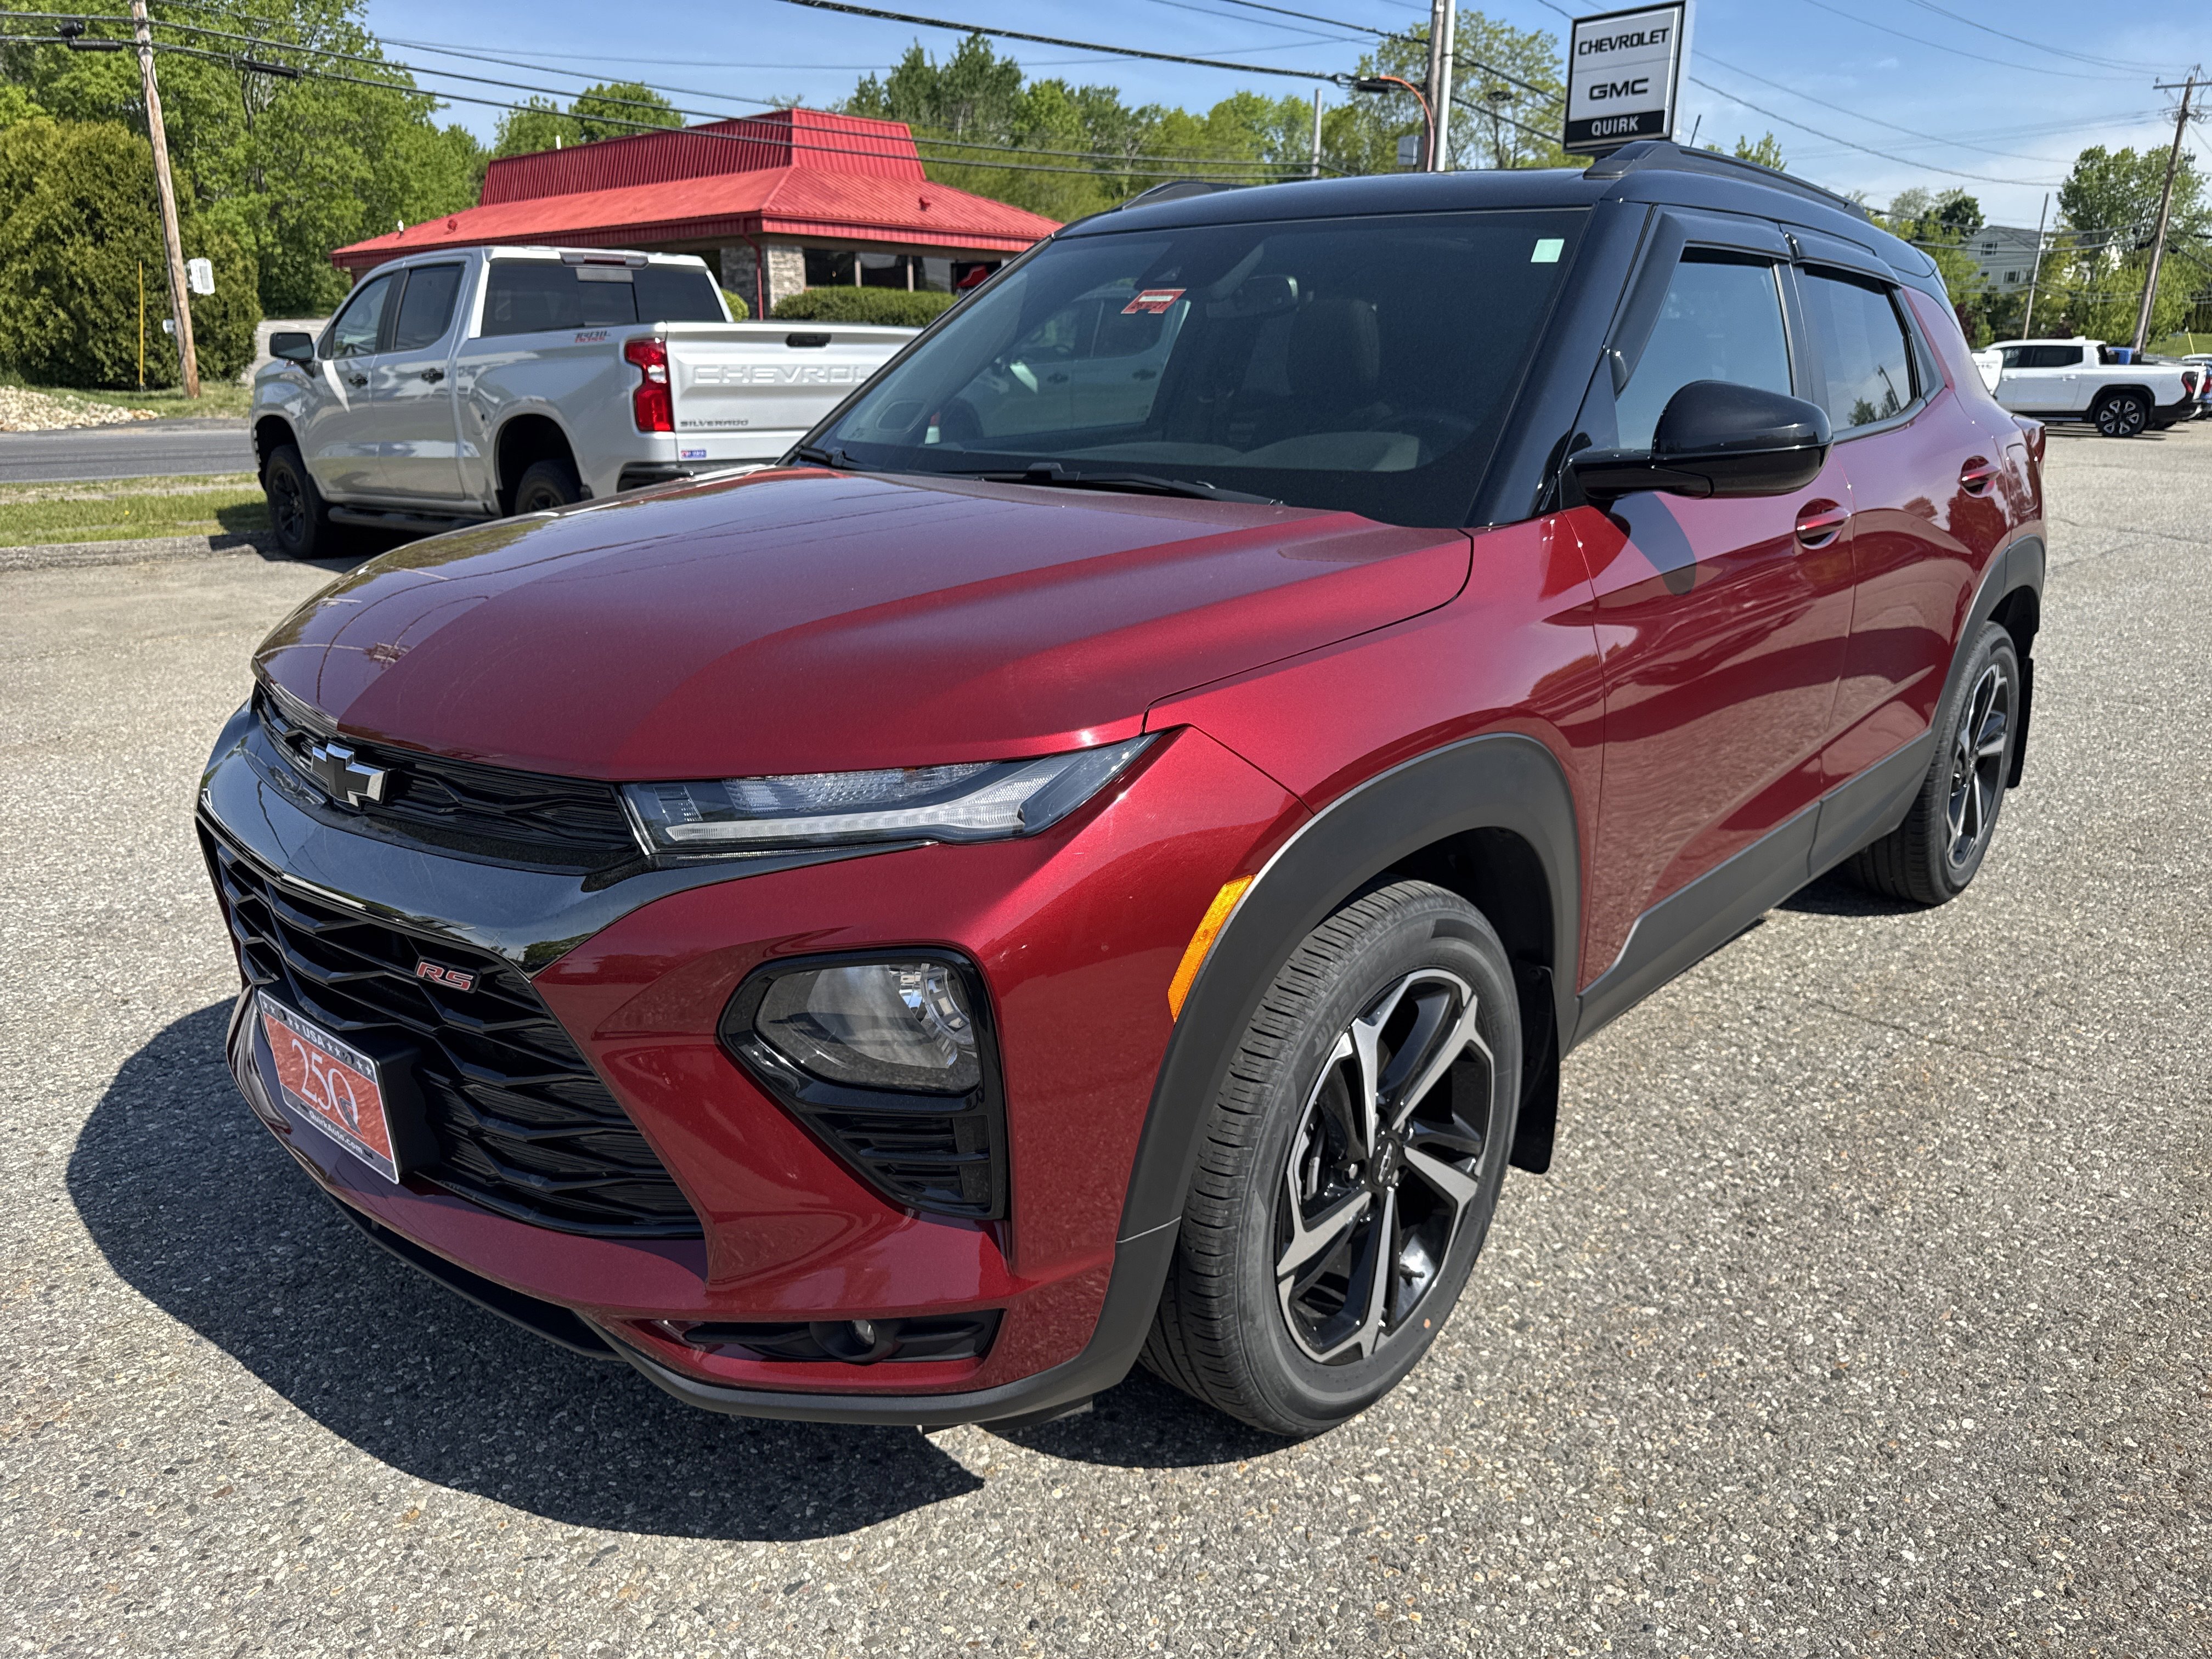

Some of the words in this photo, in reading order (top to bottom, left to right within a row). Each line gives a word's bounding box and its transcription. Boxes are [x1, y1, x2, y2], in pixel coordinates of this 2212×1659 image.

[1578, 27, 1669, 55] CHEVROLET
[1589, 78, 1649, 100] GMC
[1592, 115, 1641, 137] QUIRK
[693, 366, 879, 383] CHEVROL
[417, 962, 474, 990] RS
[302, 1024, 326, 1049] USA
[309, 1110, 363, 1154] QuirkAuto.com
